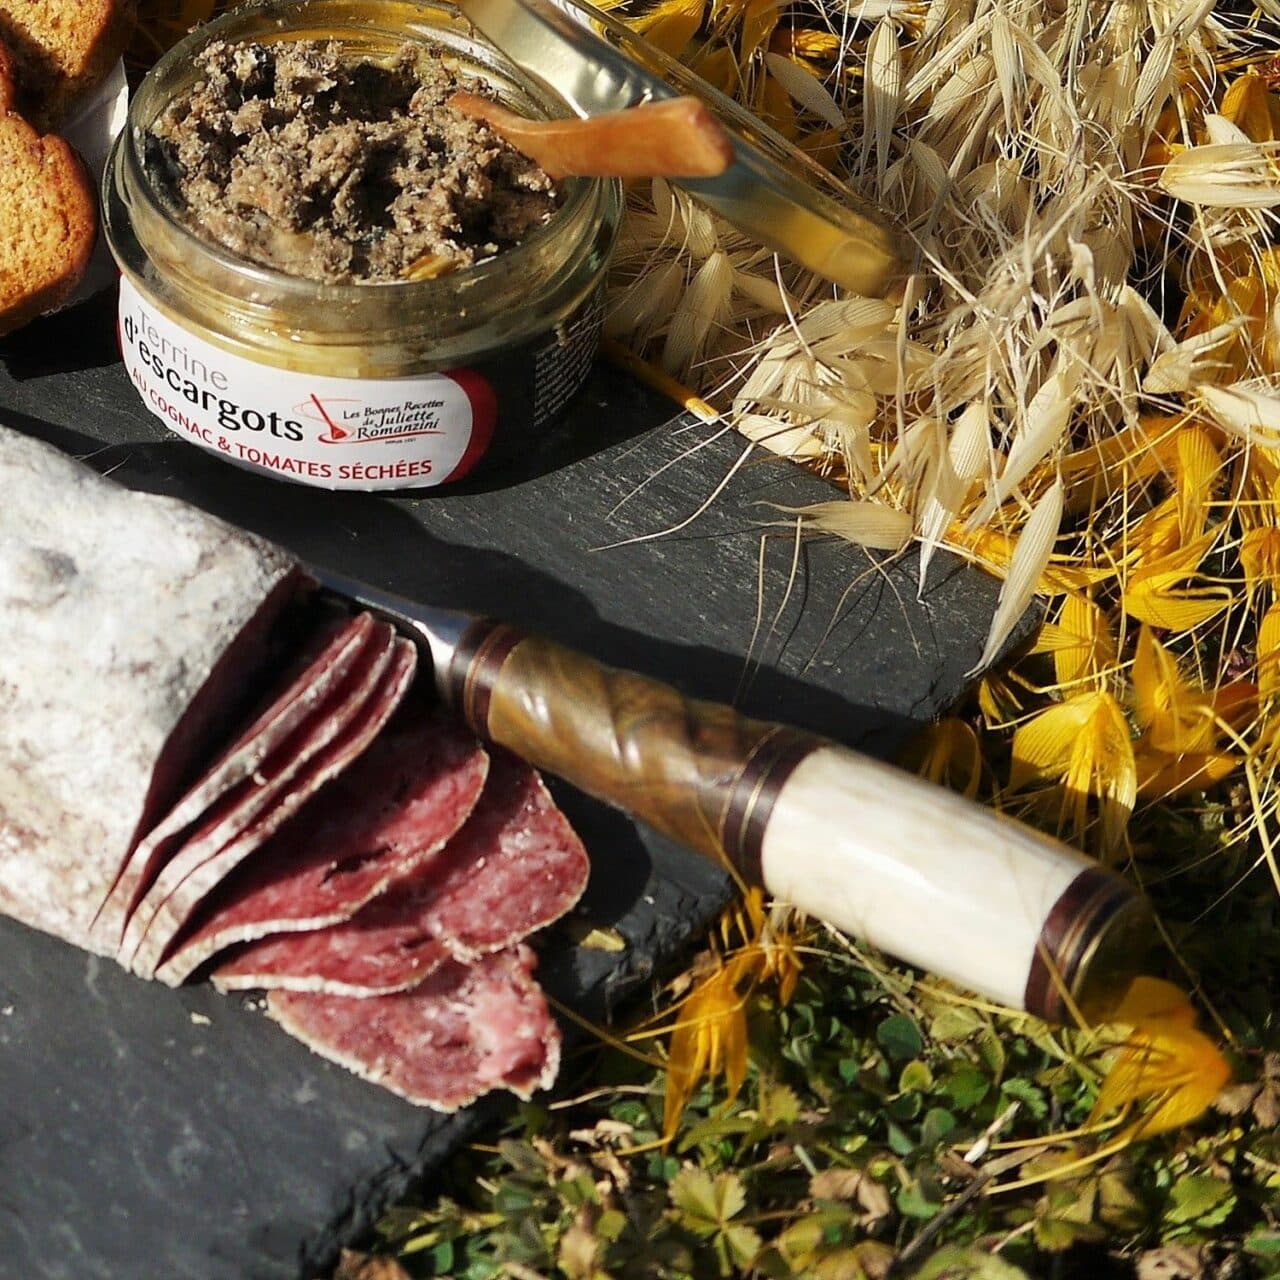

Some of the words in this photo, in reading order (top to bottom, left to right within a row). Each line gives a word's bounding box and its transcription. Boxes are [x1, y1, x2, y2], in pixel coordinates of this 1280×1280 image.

[137, 304, 229, 391] Terrine
[132, 367, 148, 393] AU
[149, 386, 214, 445] COGNAC
[217, 436, 233, 453] &
[234, 443, 332, 479] TOMATES
[338, 460, 433, 481] SÉCHÉES
[357, 418, 440, 439] Romanzini
[374, 410, 435, 429] Juliette
